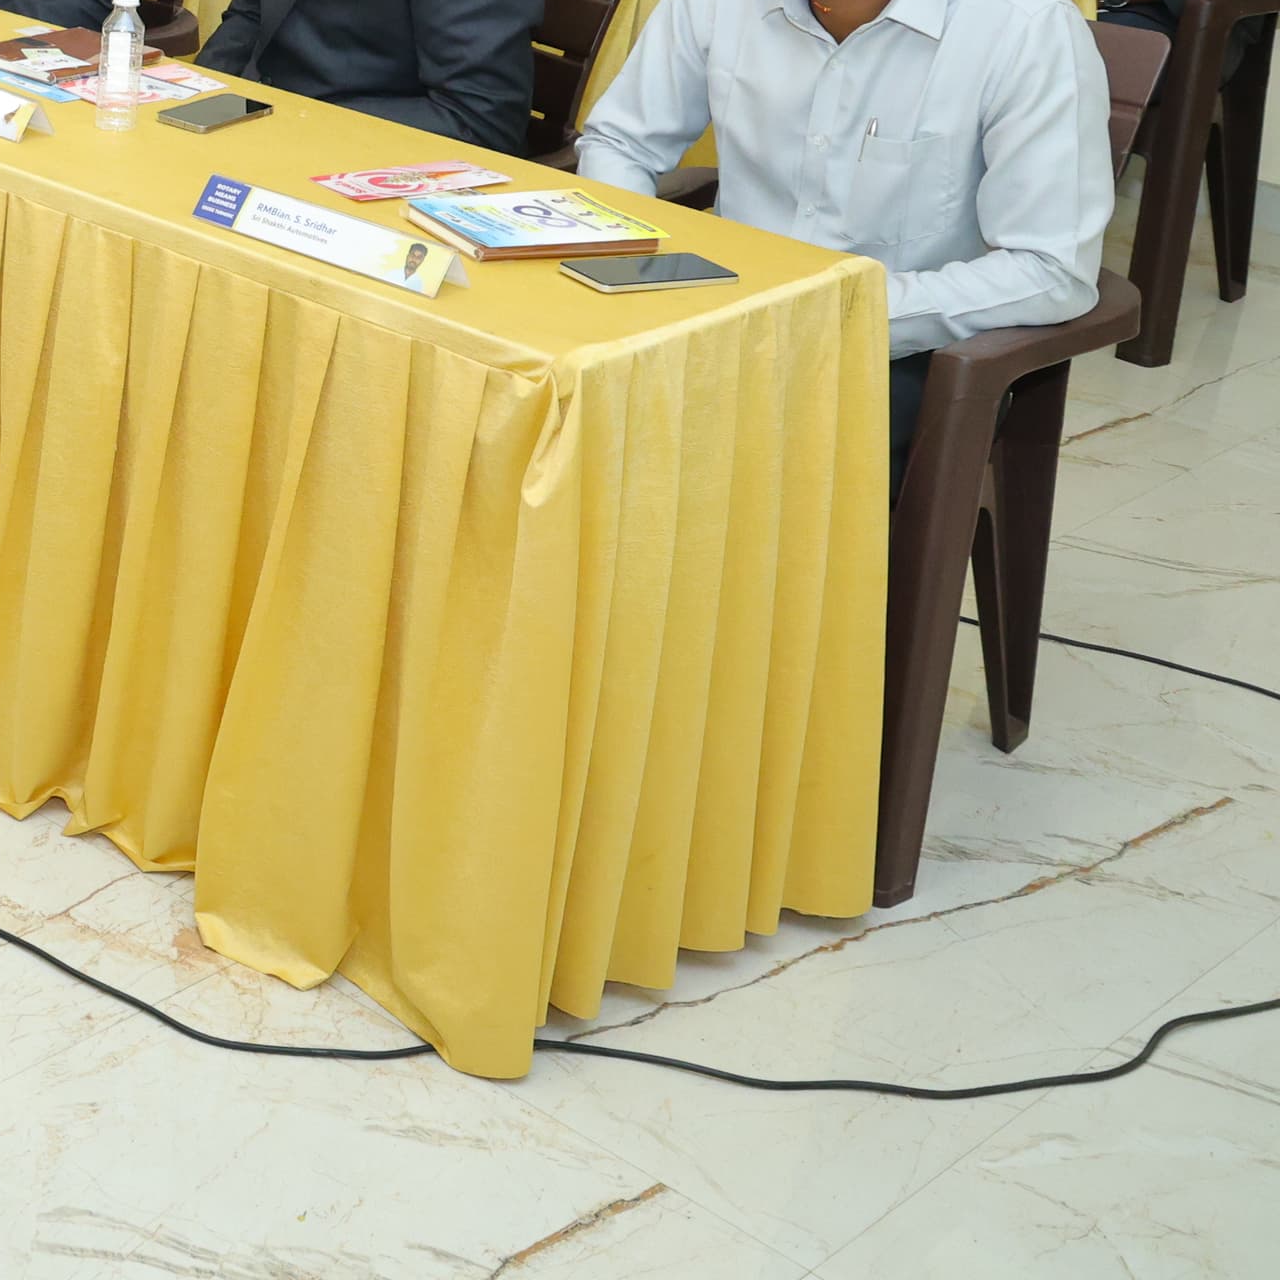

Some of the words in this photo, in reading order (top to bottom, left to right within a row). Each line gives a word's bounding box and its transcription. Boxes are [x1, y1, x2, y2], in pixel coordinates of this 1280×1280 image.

[214, 190, 237, 202] MEANS
[216, 183, 242, 196] ROTARY
[208, 196, 237, 210] BUSINESS
[251, 214, 261, 222] Sri
[287, 225, 328, 244] Automotives
[294, 215, 302, 224] S.
[304, 218, 337, 235] Sridhar
